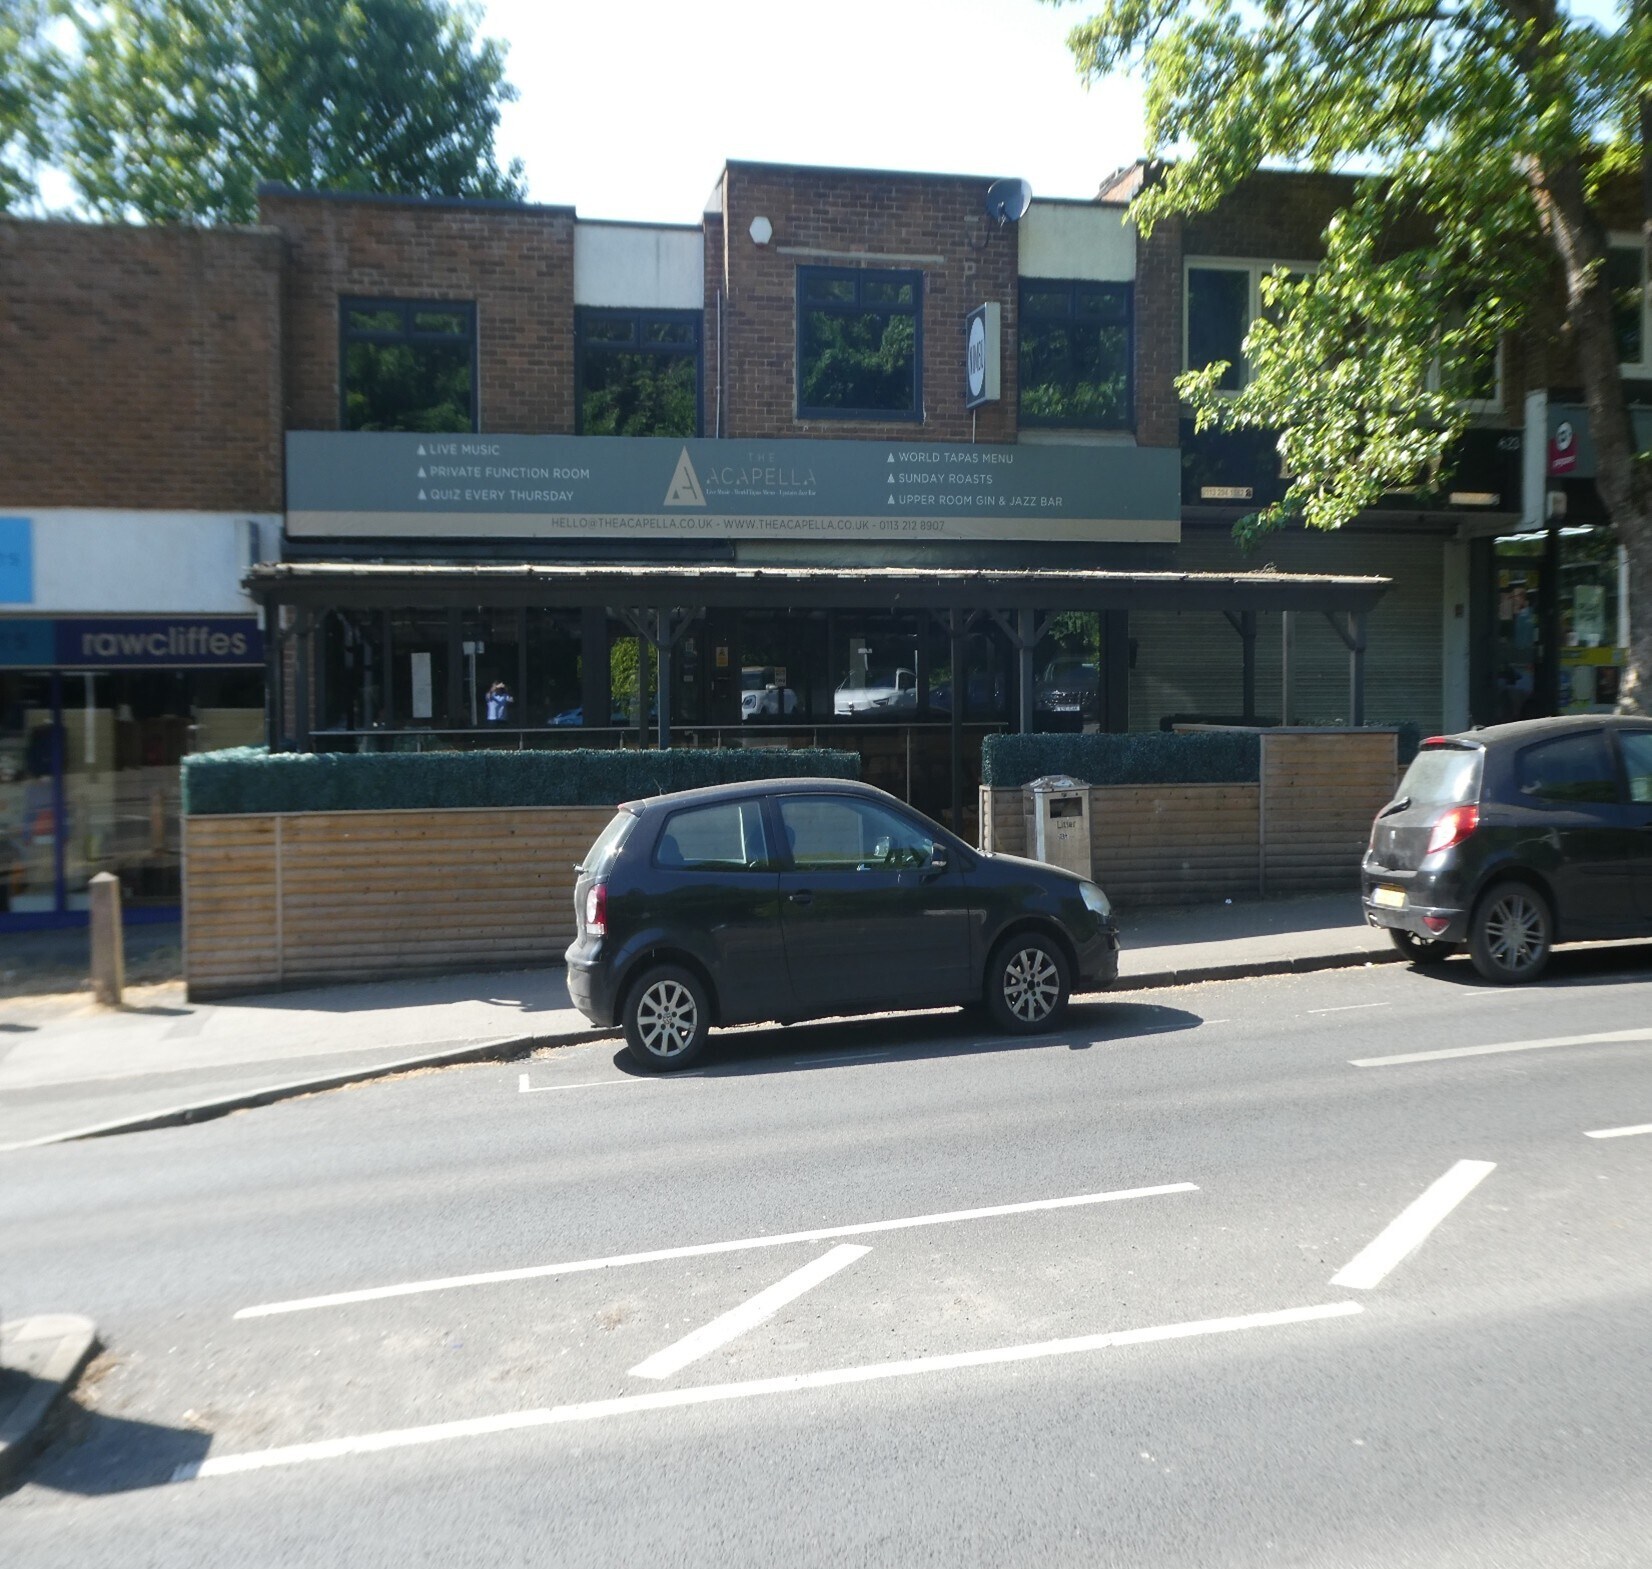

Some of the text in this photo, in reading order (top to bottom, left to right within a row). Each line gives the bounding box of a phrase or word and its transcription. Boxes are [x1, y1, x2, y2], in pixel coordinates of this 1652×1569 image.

[429, 444, 500, 455] LIVE MUSIC
[748, 453, 775, 462] THE
[898, 452, 1013, 464] WORLD TAPAS MENU
[430, 466, 590, 479] PRIVATE FUNCTION ROOM
[706, 467, 816, 485] ACAPELLA
[898, 474, 993, 484] SUNDAY ROASTS
[430, 489, 574, 501] QUIZ EVERY THURSDAY
[899, 495, 1063, 507] UPPER ROOM GIN & JAZZ BAR
[552, 517, 712, 529] HELLO@THEACAPELLA.CO.UK
[723, 519, 868, 530] WWW.THEACAPELLA.CO.UK
[879, 520, 899, 530] 0113
[901, 520, 916, 530] 212
[920, 520, 945, 531] 8907
[82, 626, 247, 656] rawcliffes
[1056, 820, 1077, 829] Litter
